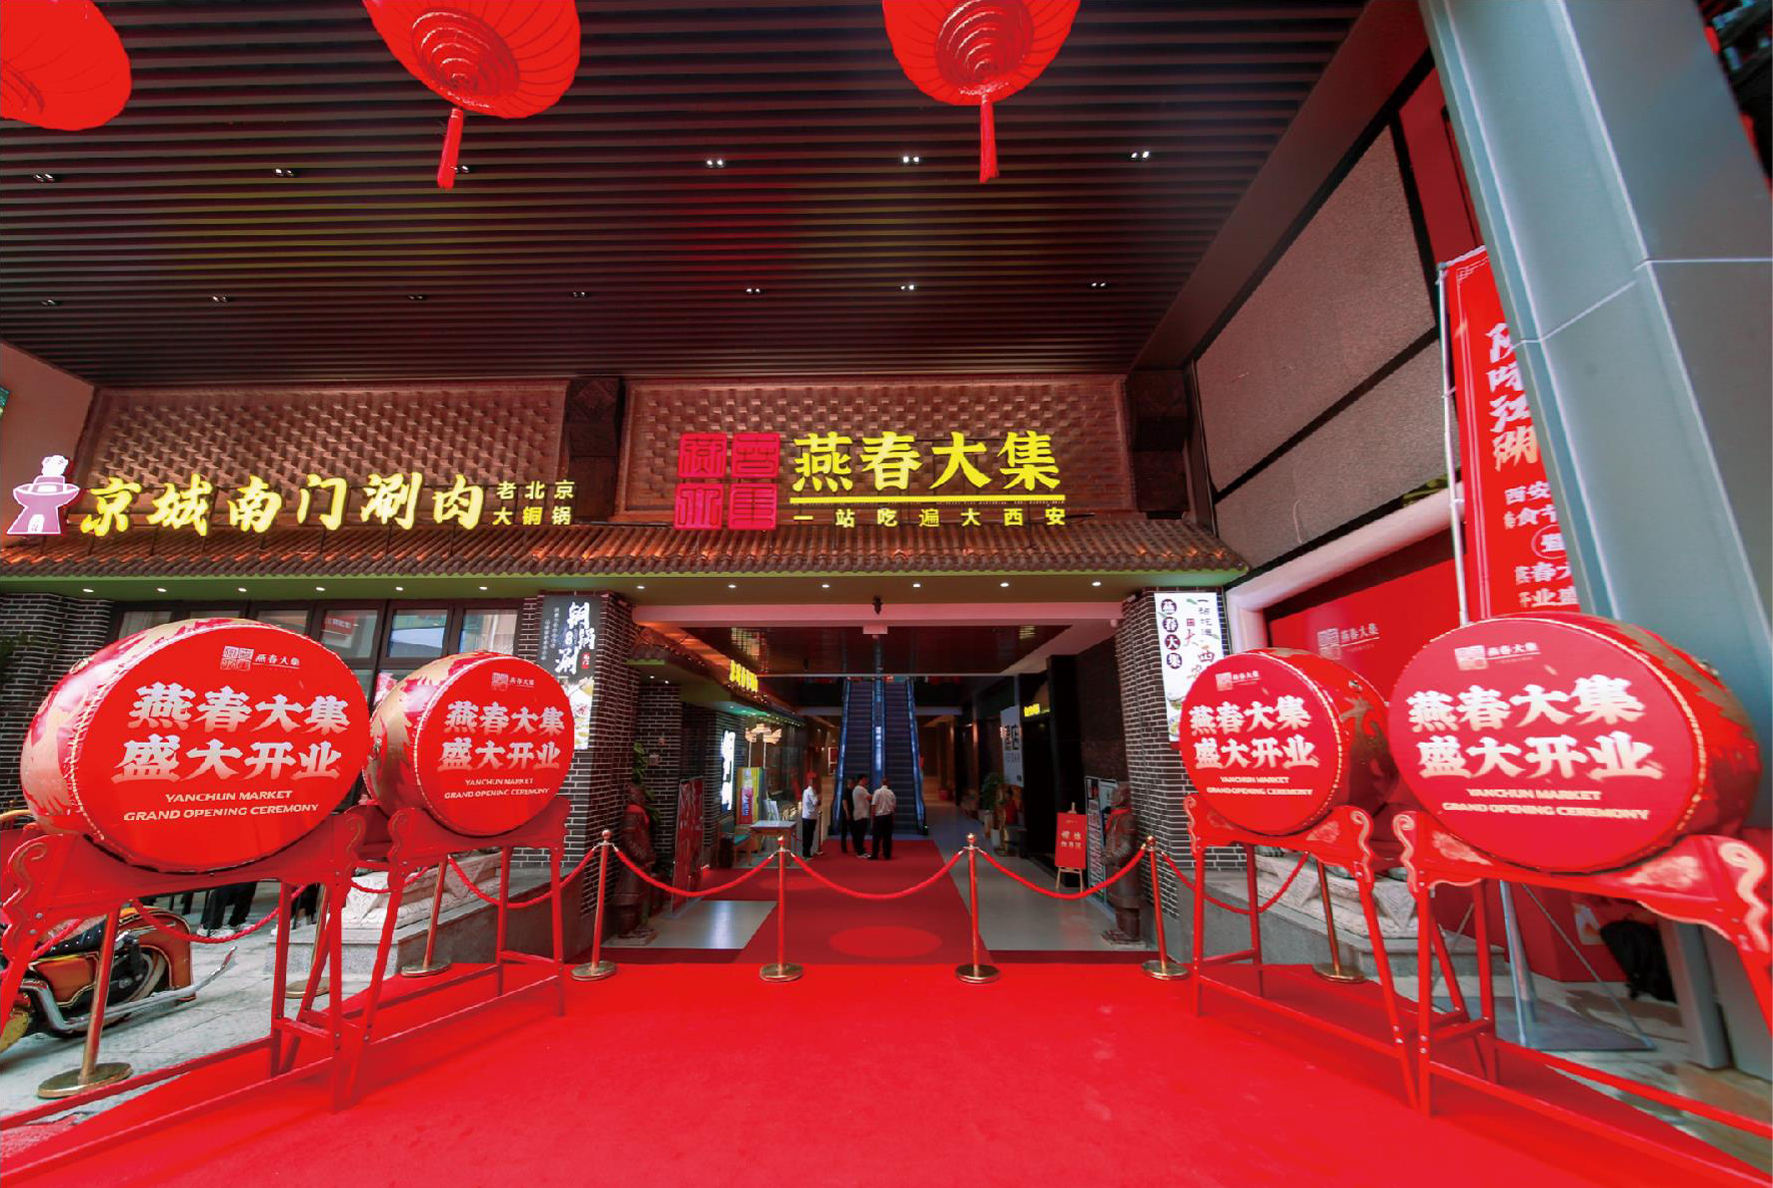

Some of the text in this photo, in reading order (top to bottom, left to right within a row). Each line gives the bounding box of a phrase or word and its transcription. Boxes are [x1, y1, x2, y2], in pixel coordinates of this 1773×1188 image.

[792, 430, 1061, 493] 燕春大集
[80, 472, 484, 537] 京城南门涮肉
[496, 479, 575, 500] 老北京
[492, 506, 572, 526] 大铜锅
[793, 507, 1066, 529] 一站吃遍大西安
[127, 680, 351, 735] 燕春大集
[443, 700, 565, 736] 燕春大集
[1188, 694, 1312, 736] 燕春大集
[1406, 674, 1646, 733] 燕春大集
[111, 733, 342, 784] 盛大开业
[437, 737, 561, 772] 盛大开业
[1193, 734, 1320, 770] 盛大开业
[1415, 730, 1664, 781] 盛大开业
[165, 790, 293, 803] YANCHUN MARKET
[1442, 802, 1649, 821] GRAND OPENING CEREMONY
[1466, 788, 1602, 800] YANCHUN MARKET
[124, 804, 319, 821] GRAND OPENING CEREMONY
